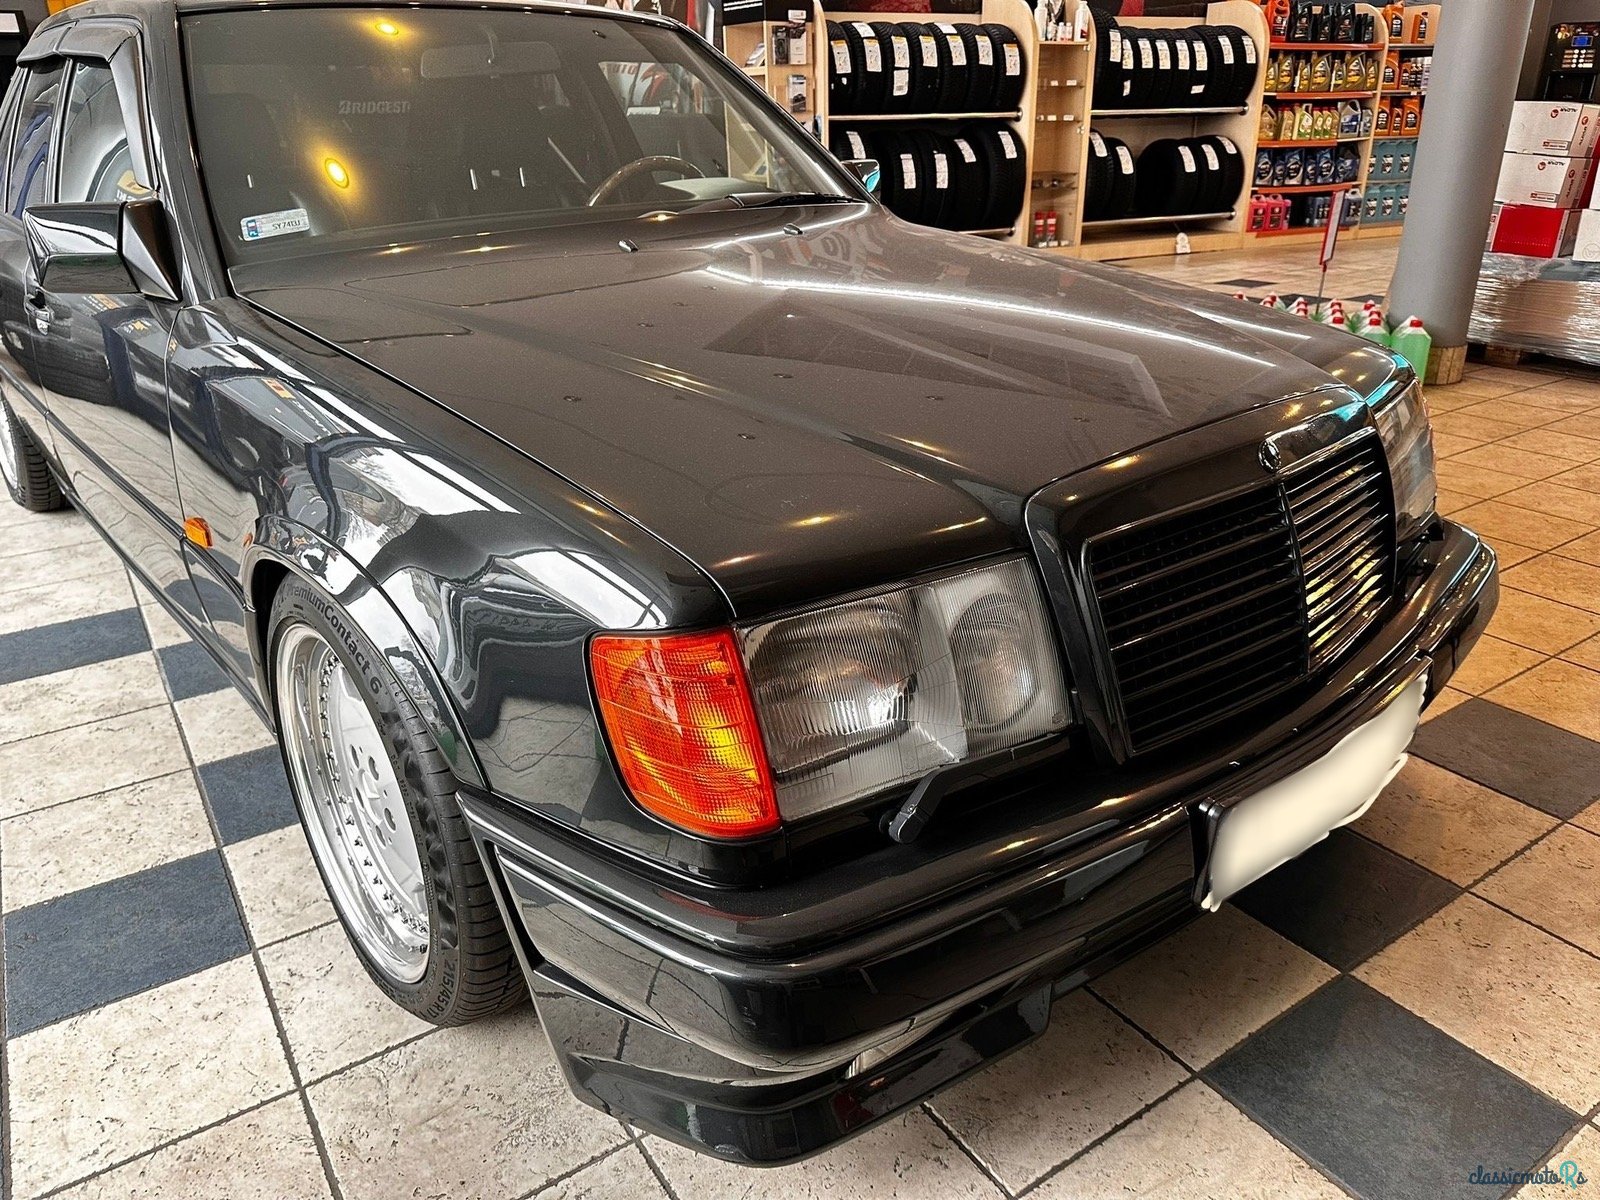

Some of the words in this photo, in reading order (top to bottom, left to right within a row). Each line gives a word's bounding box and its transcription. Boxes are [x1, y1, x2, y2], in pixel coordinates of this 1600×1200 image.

[286, 583, 371, 675] PremiumContact
[370, 676, 383, 695] 6
[437, 959, 456, 1007] 215/45
